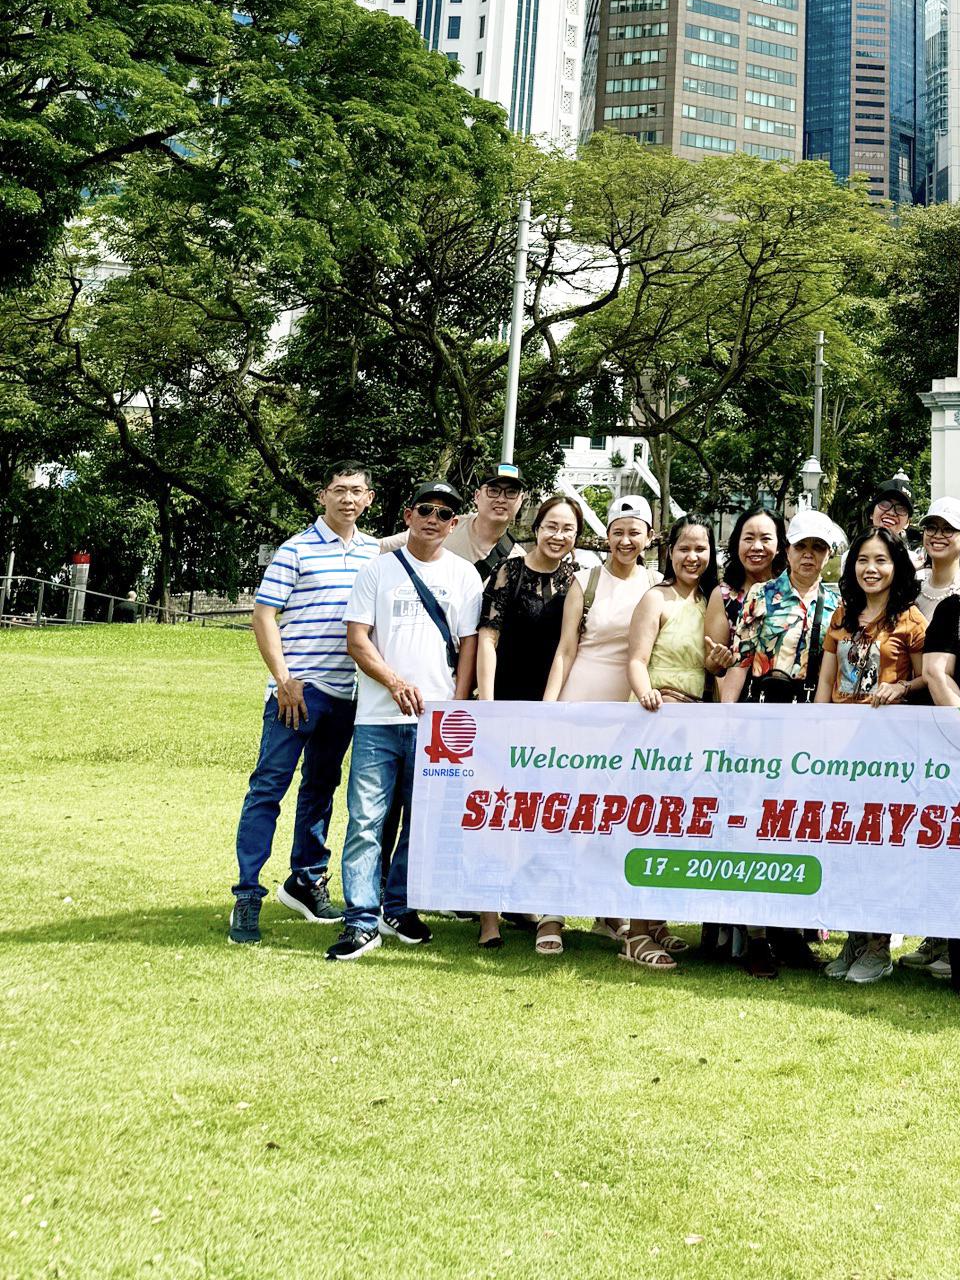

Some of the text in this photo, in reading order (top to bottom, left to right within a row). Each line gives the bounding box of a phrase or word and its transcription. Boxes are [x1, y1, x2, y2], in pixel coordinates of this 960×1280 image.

[422, 768, 475, 777] SUNRISE CO
[509, 746, 950, 783] Welcome Nhat Thang Company to
[643, 857, 668, 876] 17
[686, 858, 806, 884] 20/04/2024
